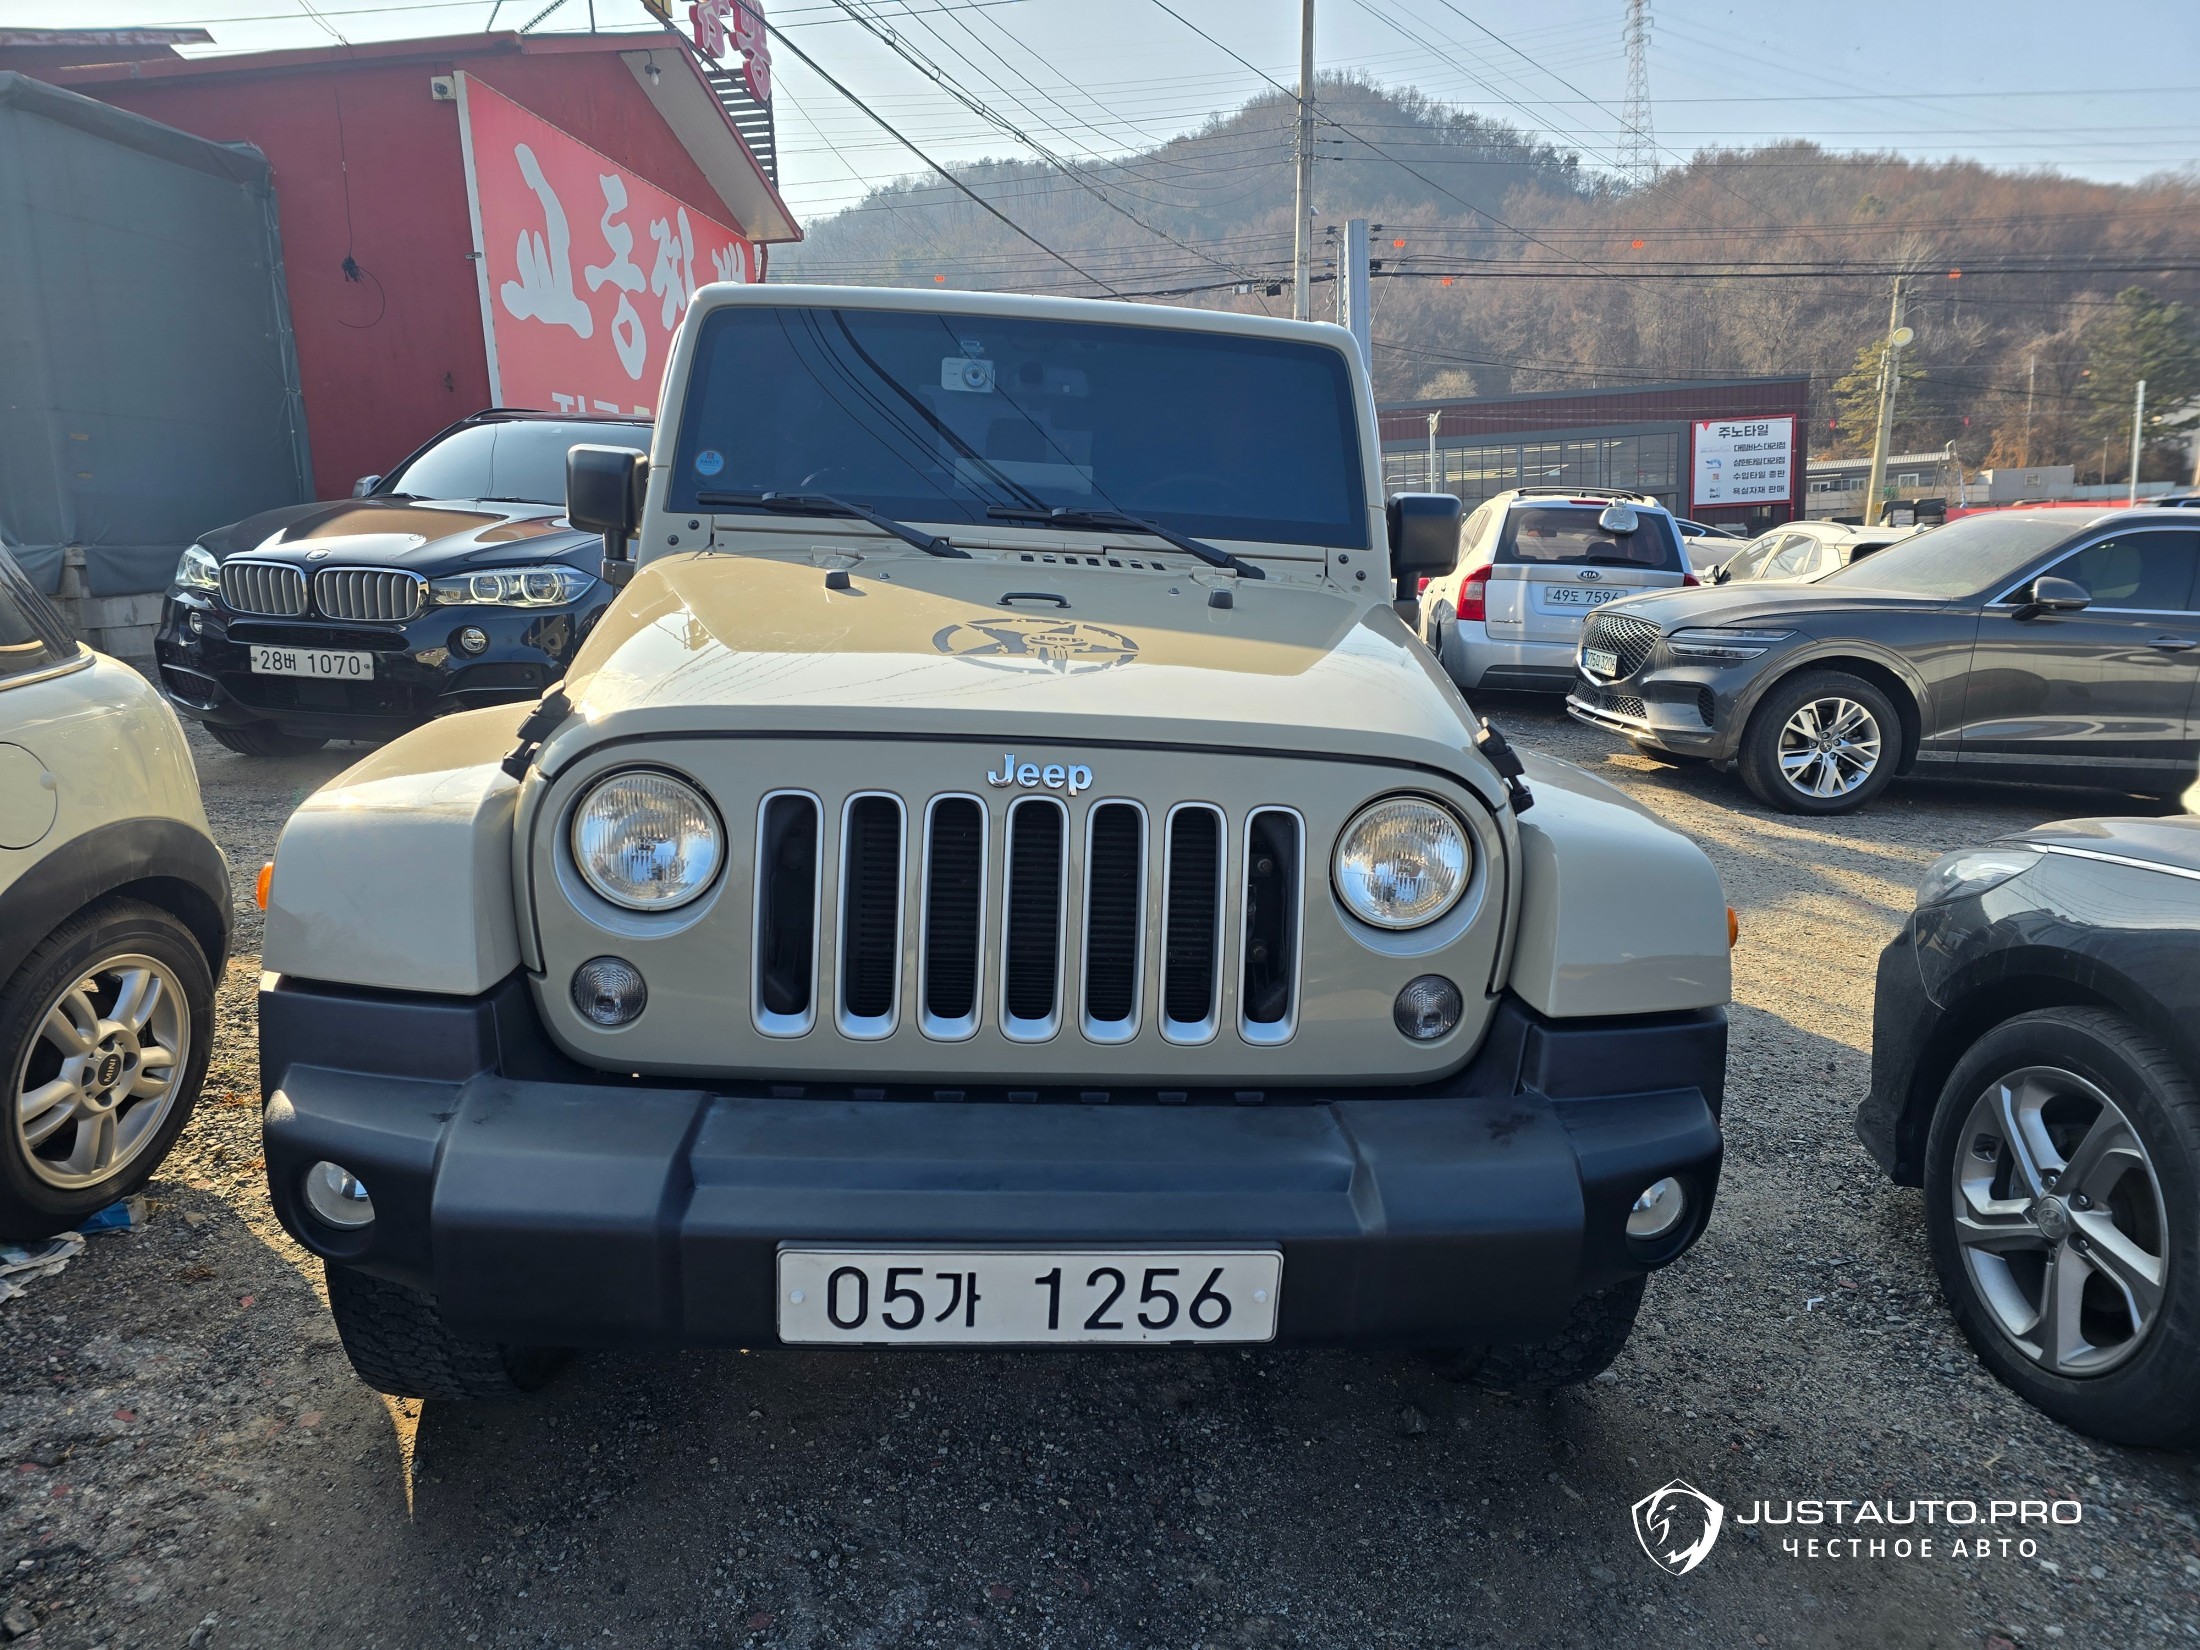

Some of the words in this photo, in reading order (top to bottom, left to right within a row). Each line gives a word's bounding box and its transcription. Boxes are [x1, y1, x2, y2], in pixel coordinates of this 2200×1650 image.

[1718, 424, 1768, 438] 주노타일
[1733, 443, 1763, 452] 대림바스
[1763, 441, 1786, 450] 대리점
[1763, 456, 1786, 465] 대리점
[1733, 471, 1766, 480] 수입타일
[1768, 470, 1785, 479] 총판
[1733, 487, 1766, 495] 욕실자재
[1768, 485, 1785, 494] 판매
[1553, 589, 1579, 602] 49도
[307, 653, 360, 676] 1070
[1601, 656, 1616, 672] 3206
[987, 753, 1093, 796] Jeep
[103, 1058, 117, 1082] MINI
[827, 1266, 982, 1330] 05가
[1034, 1267, 1232, 1330] 1256
